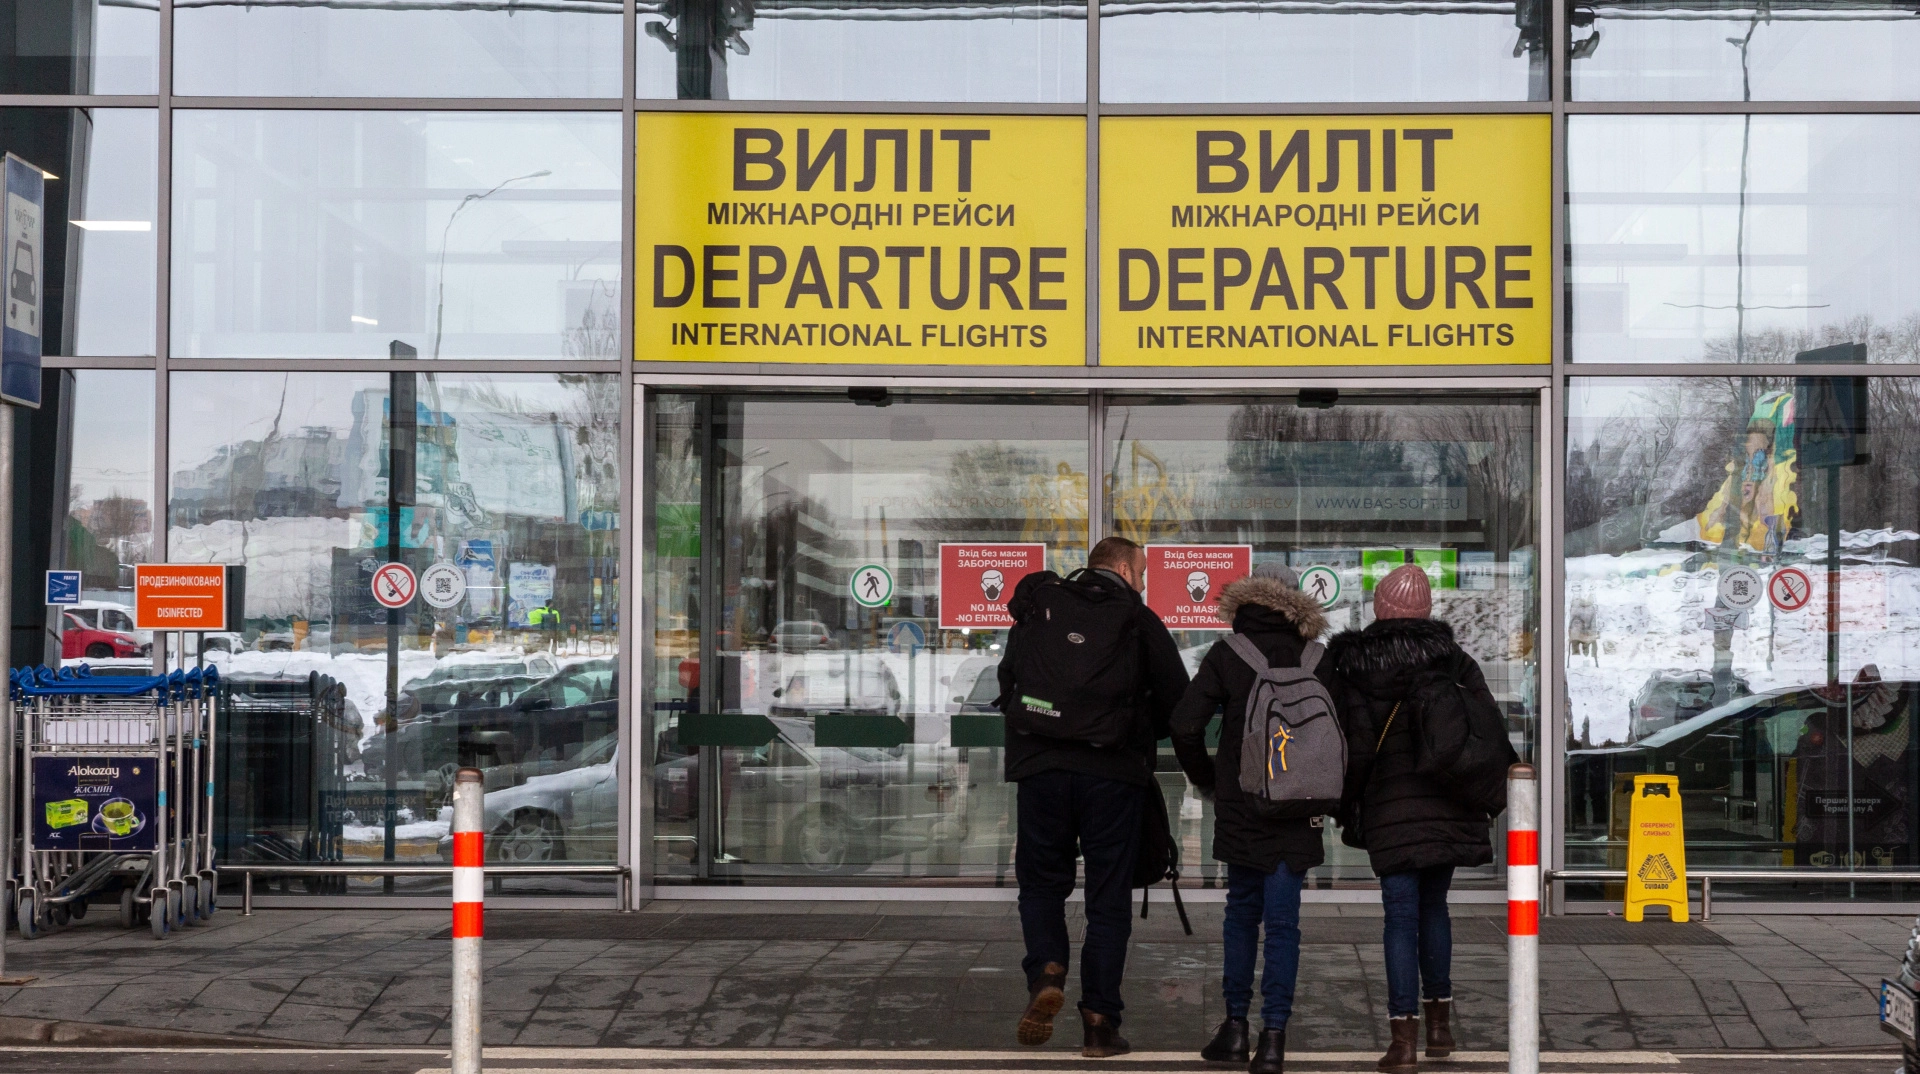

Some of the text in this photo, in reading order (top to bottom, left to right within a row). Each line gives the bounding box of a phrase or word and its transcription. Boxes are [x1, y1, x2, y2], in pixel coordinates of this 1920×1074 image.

[733, 128, 990, 192] ВИЛІТ
[1196, 128, 1453, 194] ВИЛІТ
[707, 198, 1015, 231] МІЖНАРОДНІ РЕЙСИ
[1171, 197, 1479, 231] МІЖНАРОДНІ РЕЙСИ
[653, 244, 1068, 311] DEPARTURE
[1118, 245, 1534, 312] DEPARTURE
[671, 323, 1048, 348] INTERNATIONAL FLIGHTS
[1138, 323, 1515, 349] INTERNATIONAL FLIGHTS
[1315, 497, 1460, 511] WWW.BAS-SOFT.EU
[958, 549, 979, 558] Вхід
[981, 549, 997, 557] без
[1164, 551, 1185, 560] Вхід
[1187, 550, 1203, 559] без
[957, 559, 1028, 568] ЗАБОРОНЕНО!
[1163, 561, 1234, 569] ЗАБОРОНЕНО!
[139, 575, 221, 588] ПРОДЕЗИНФІКОВАНО
[157, 607, 203, 618] DISINFECTED
[970, 603, 1008, 612] NO MAS
[1176, 605, 1191, 613] NO
[975, 614, 1015, 622] ENTRAN
[67, 765, 119, 778] Alokozay
[73, 785, 113, 794] ЖАСМИН
[1637, 853, 1654, 878] ACHTUNG
[1659, 853, 1678, 880] ATTENTION
